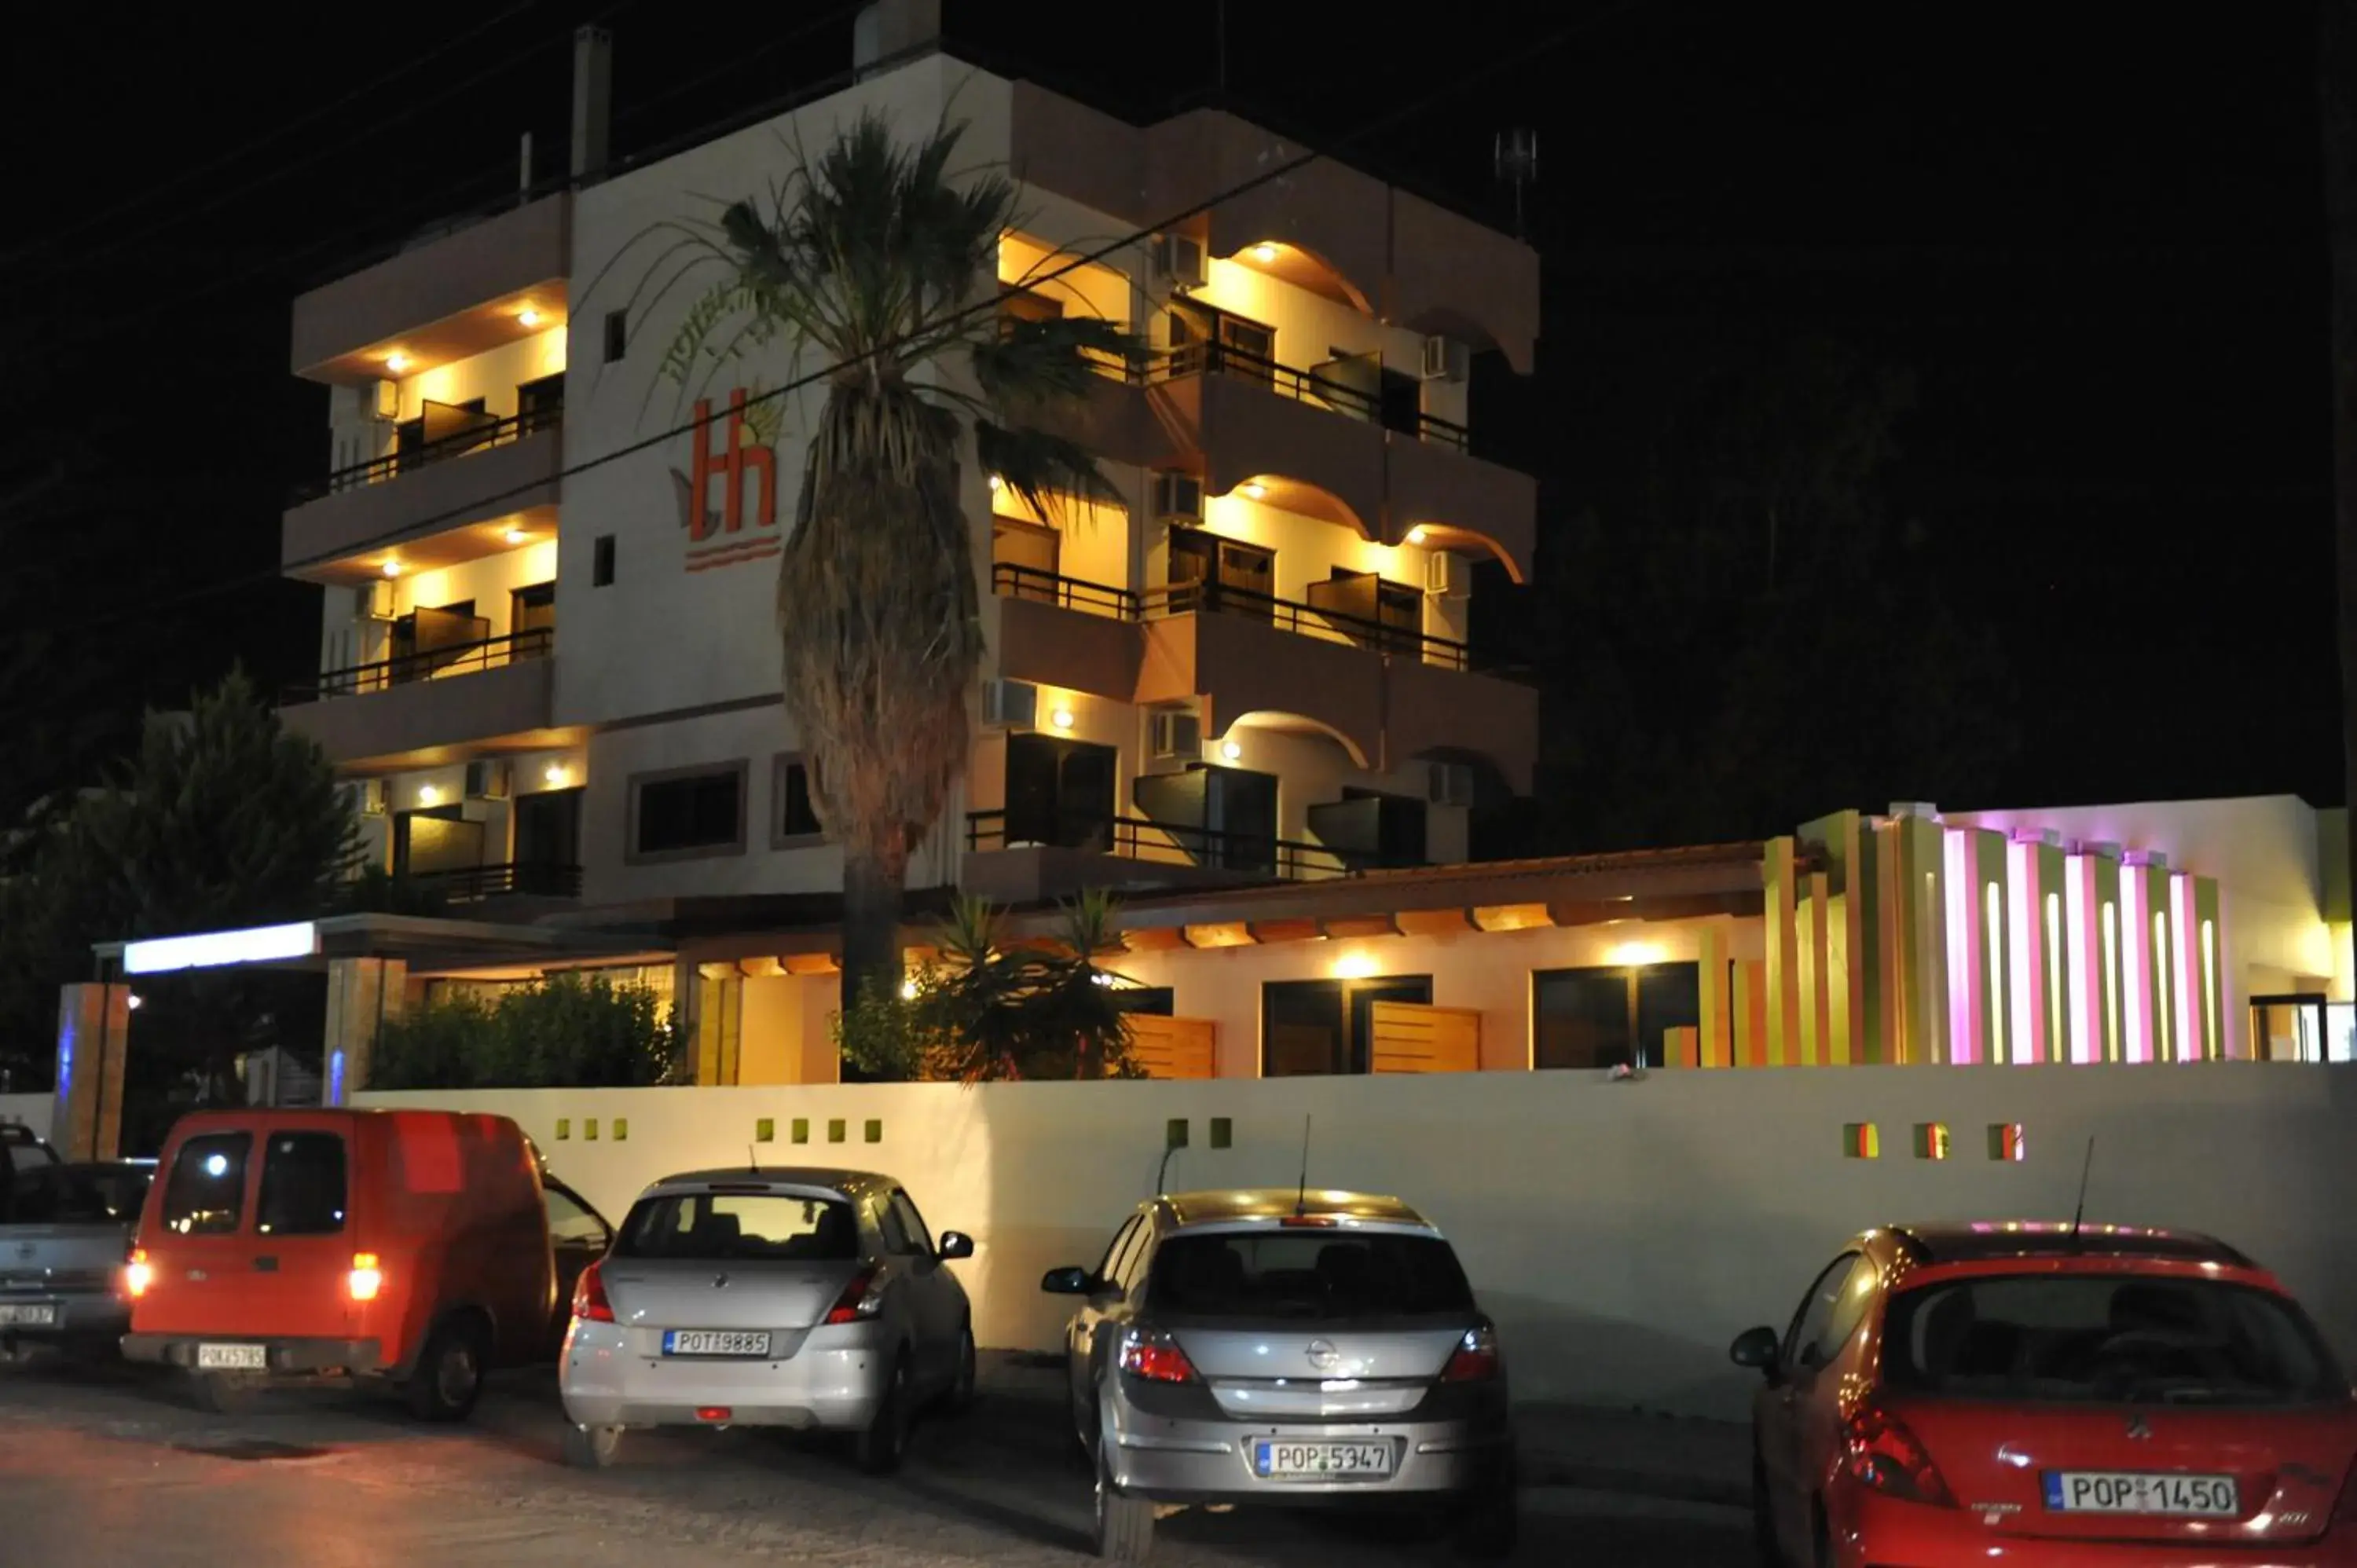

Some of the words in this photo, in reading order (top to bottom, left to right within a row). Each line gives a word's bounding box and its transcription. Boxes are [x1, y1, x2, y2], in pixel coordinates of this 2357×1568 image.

[679, 1333, 713, 1350] POT
[1277, 1447, 1318, 1468] POP
[1331, 1447, 1385, 1469] 5347
[2073, 1477, 2132, 1508] POP
[2152, 1478, 2232, 1511] 1450
